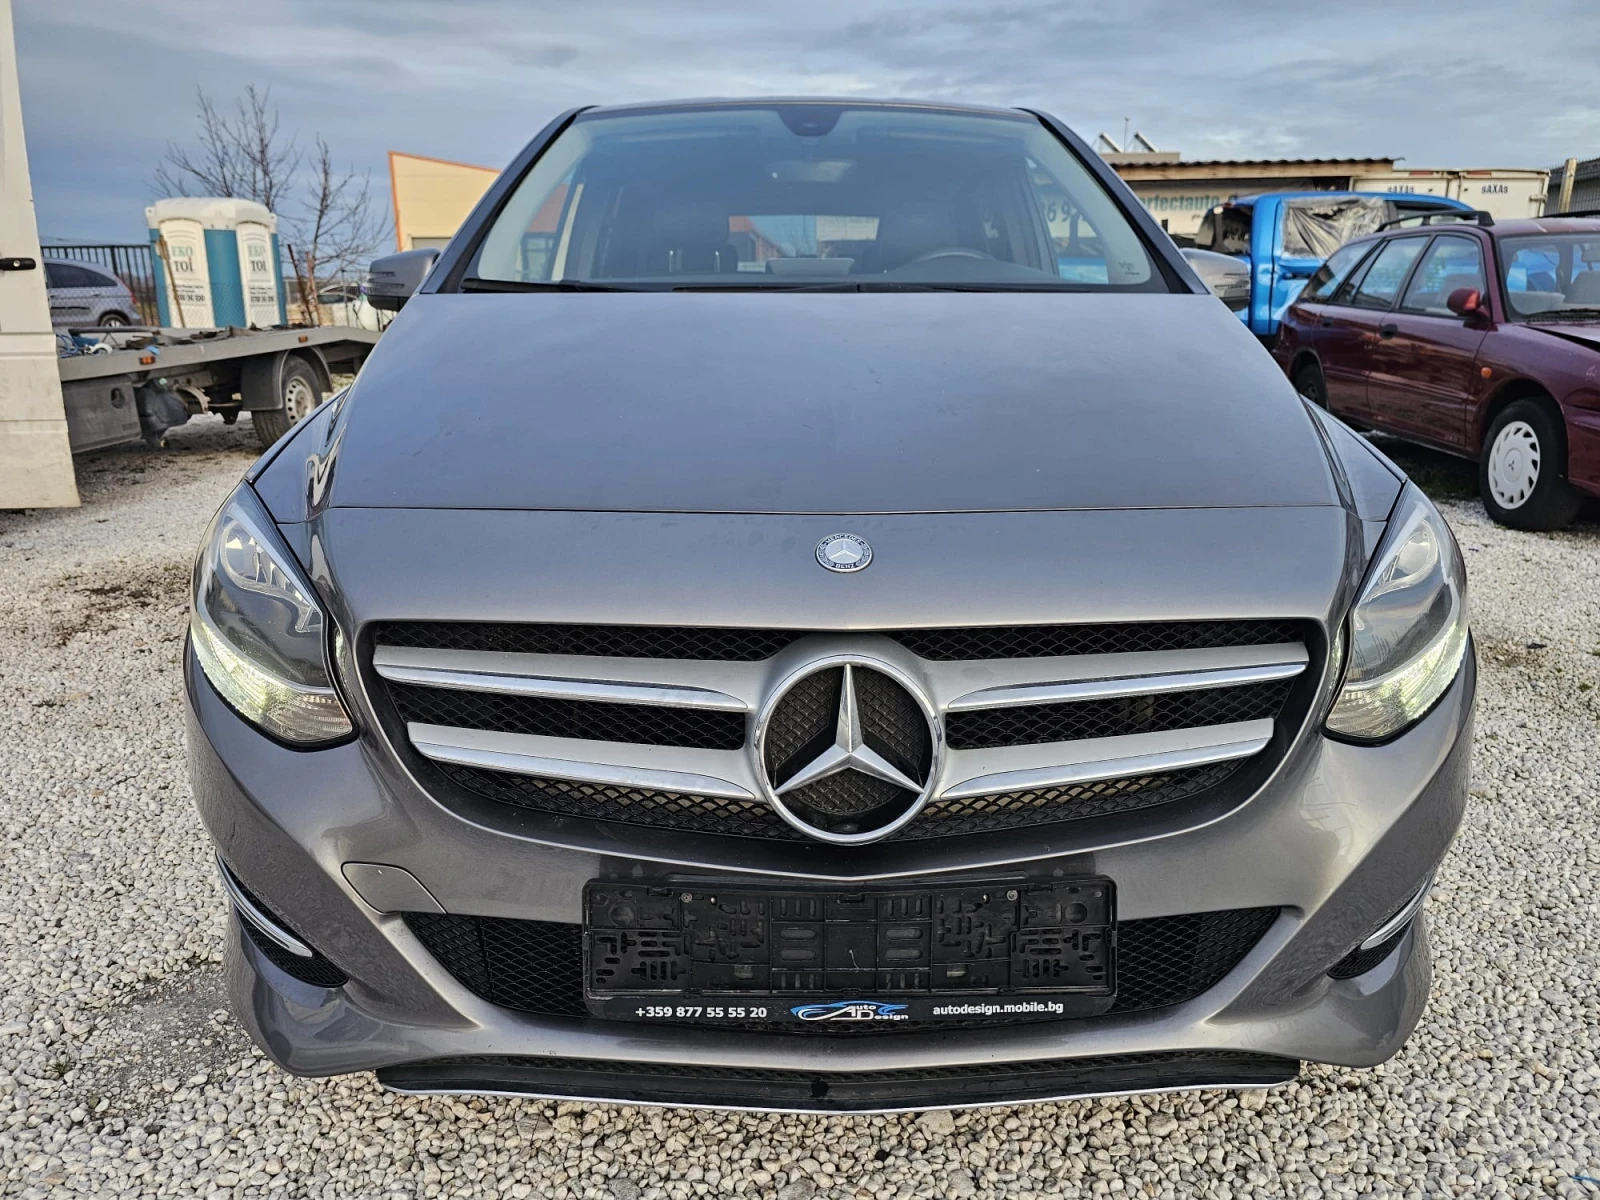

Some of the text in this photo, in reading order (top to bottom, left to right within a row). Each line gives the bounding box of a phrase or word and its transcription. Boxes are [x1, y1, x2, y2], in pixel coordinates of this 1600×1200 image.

[1138, 194, 1220, 212] erfectauto
[635, 1006, 767, 1018] +359 877 55 55 20
[932, 1001, 1064, 1015] autodesign.mobile.bg
